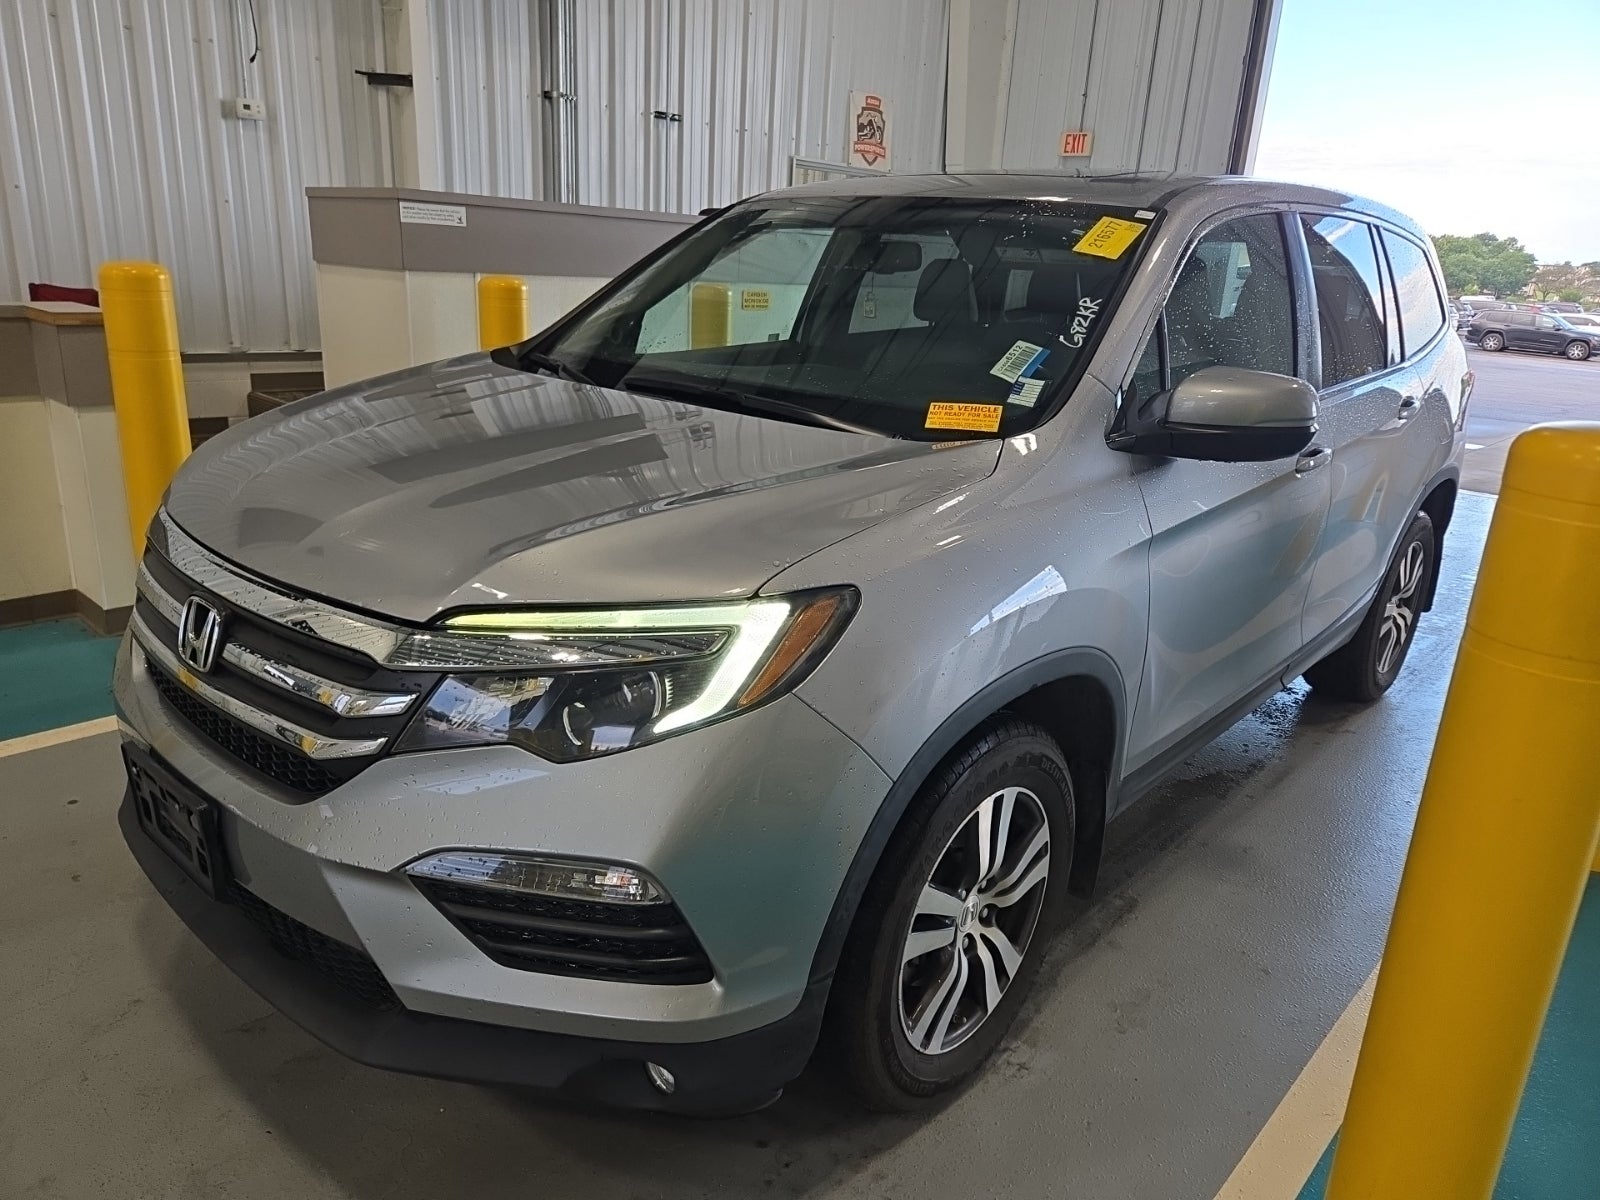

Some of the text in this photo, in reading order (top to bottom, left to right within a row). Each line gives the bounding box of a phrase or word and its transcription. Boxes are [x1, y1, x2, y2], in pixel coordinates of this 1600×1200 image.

[1064, 133, 1088, 154] EXIT
[1088, 220, 1123, 249] 216577
[958, 405, 999, 413] VEHICLE
